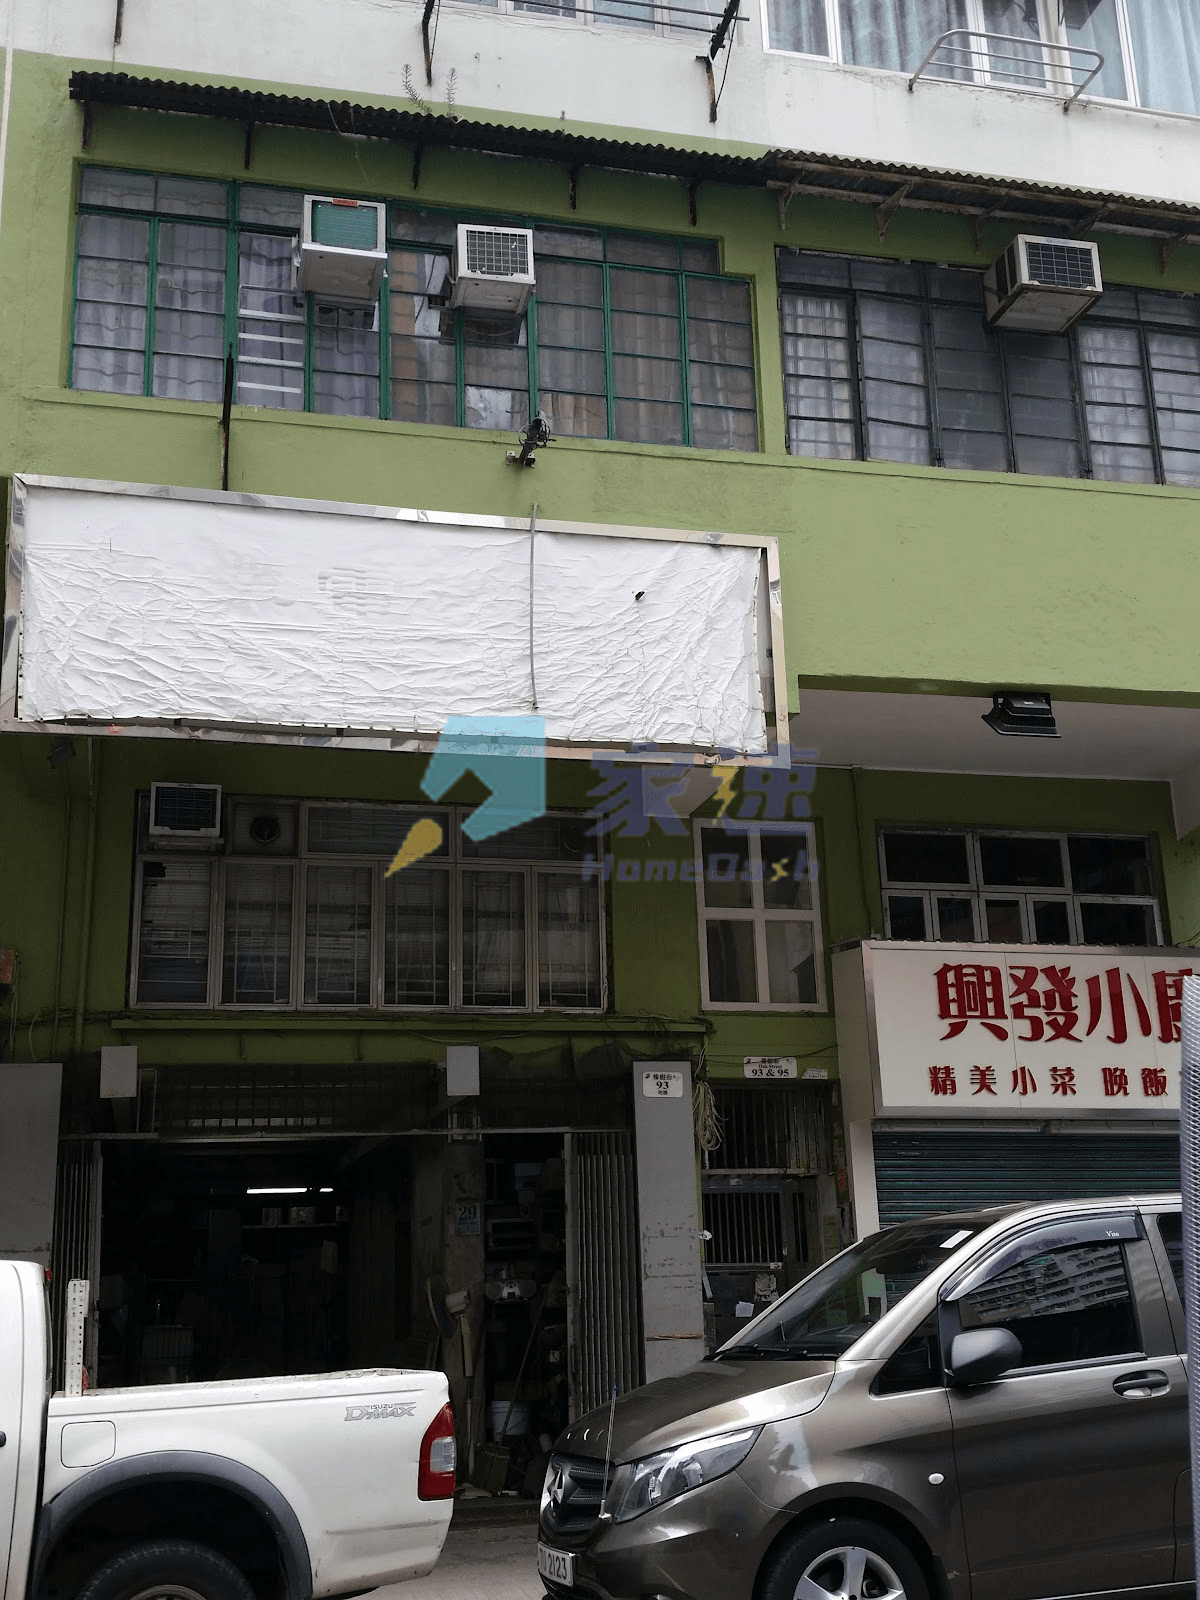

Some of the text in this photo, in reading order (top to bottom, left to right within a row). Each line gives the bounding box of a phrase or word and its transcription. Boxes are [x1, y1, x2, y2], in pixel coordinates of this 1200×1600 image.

[751, 1068, 789, 1077] 93 & 95
[928, 1065, 1182, 1096] 精美小菜 晚飯
[656, 1080, 669, 1090] 93
[547, 1552, 568, 1580] 2123
